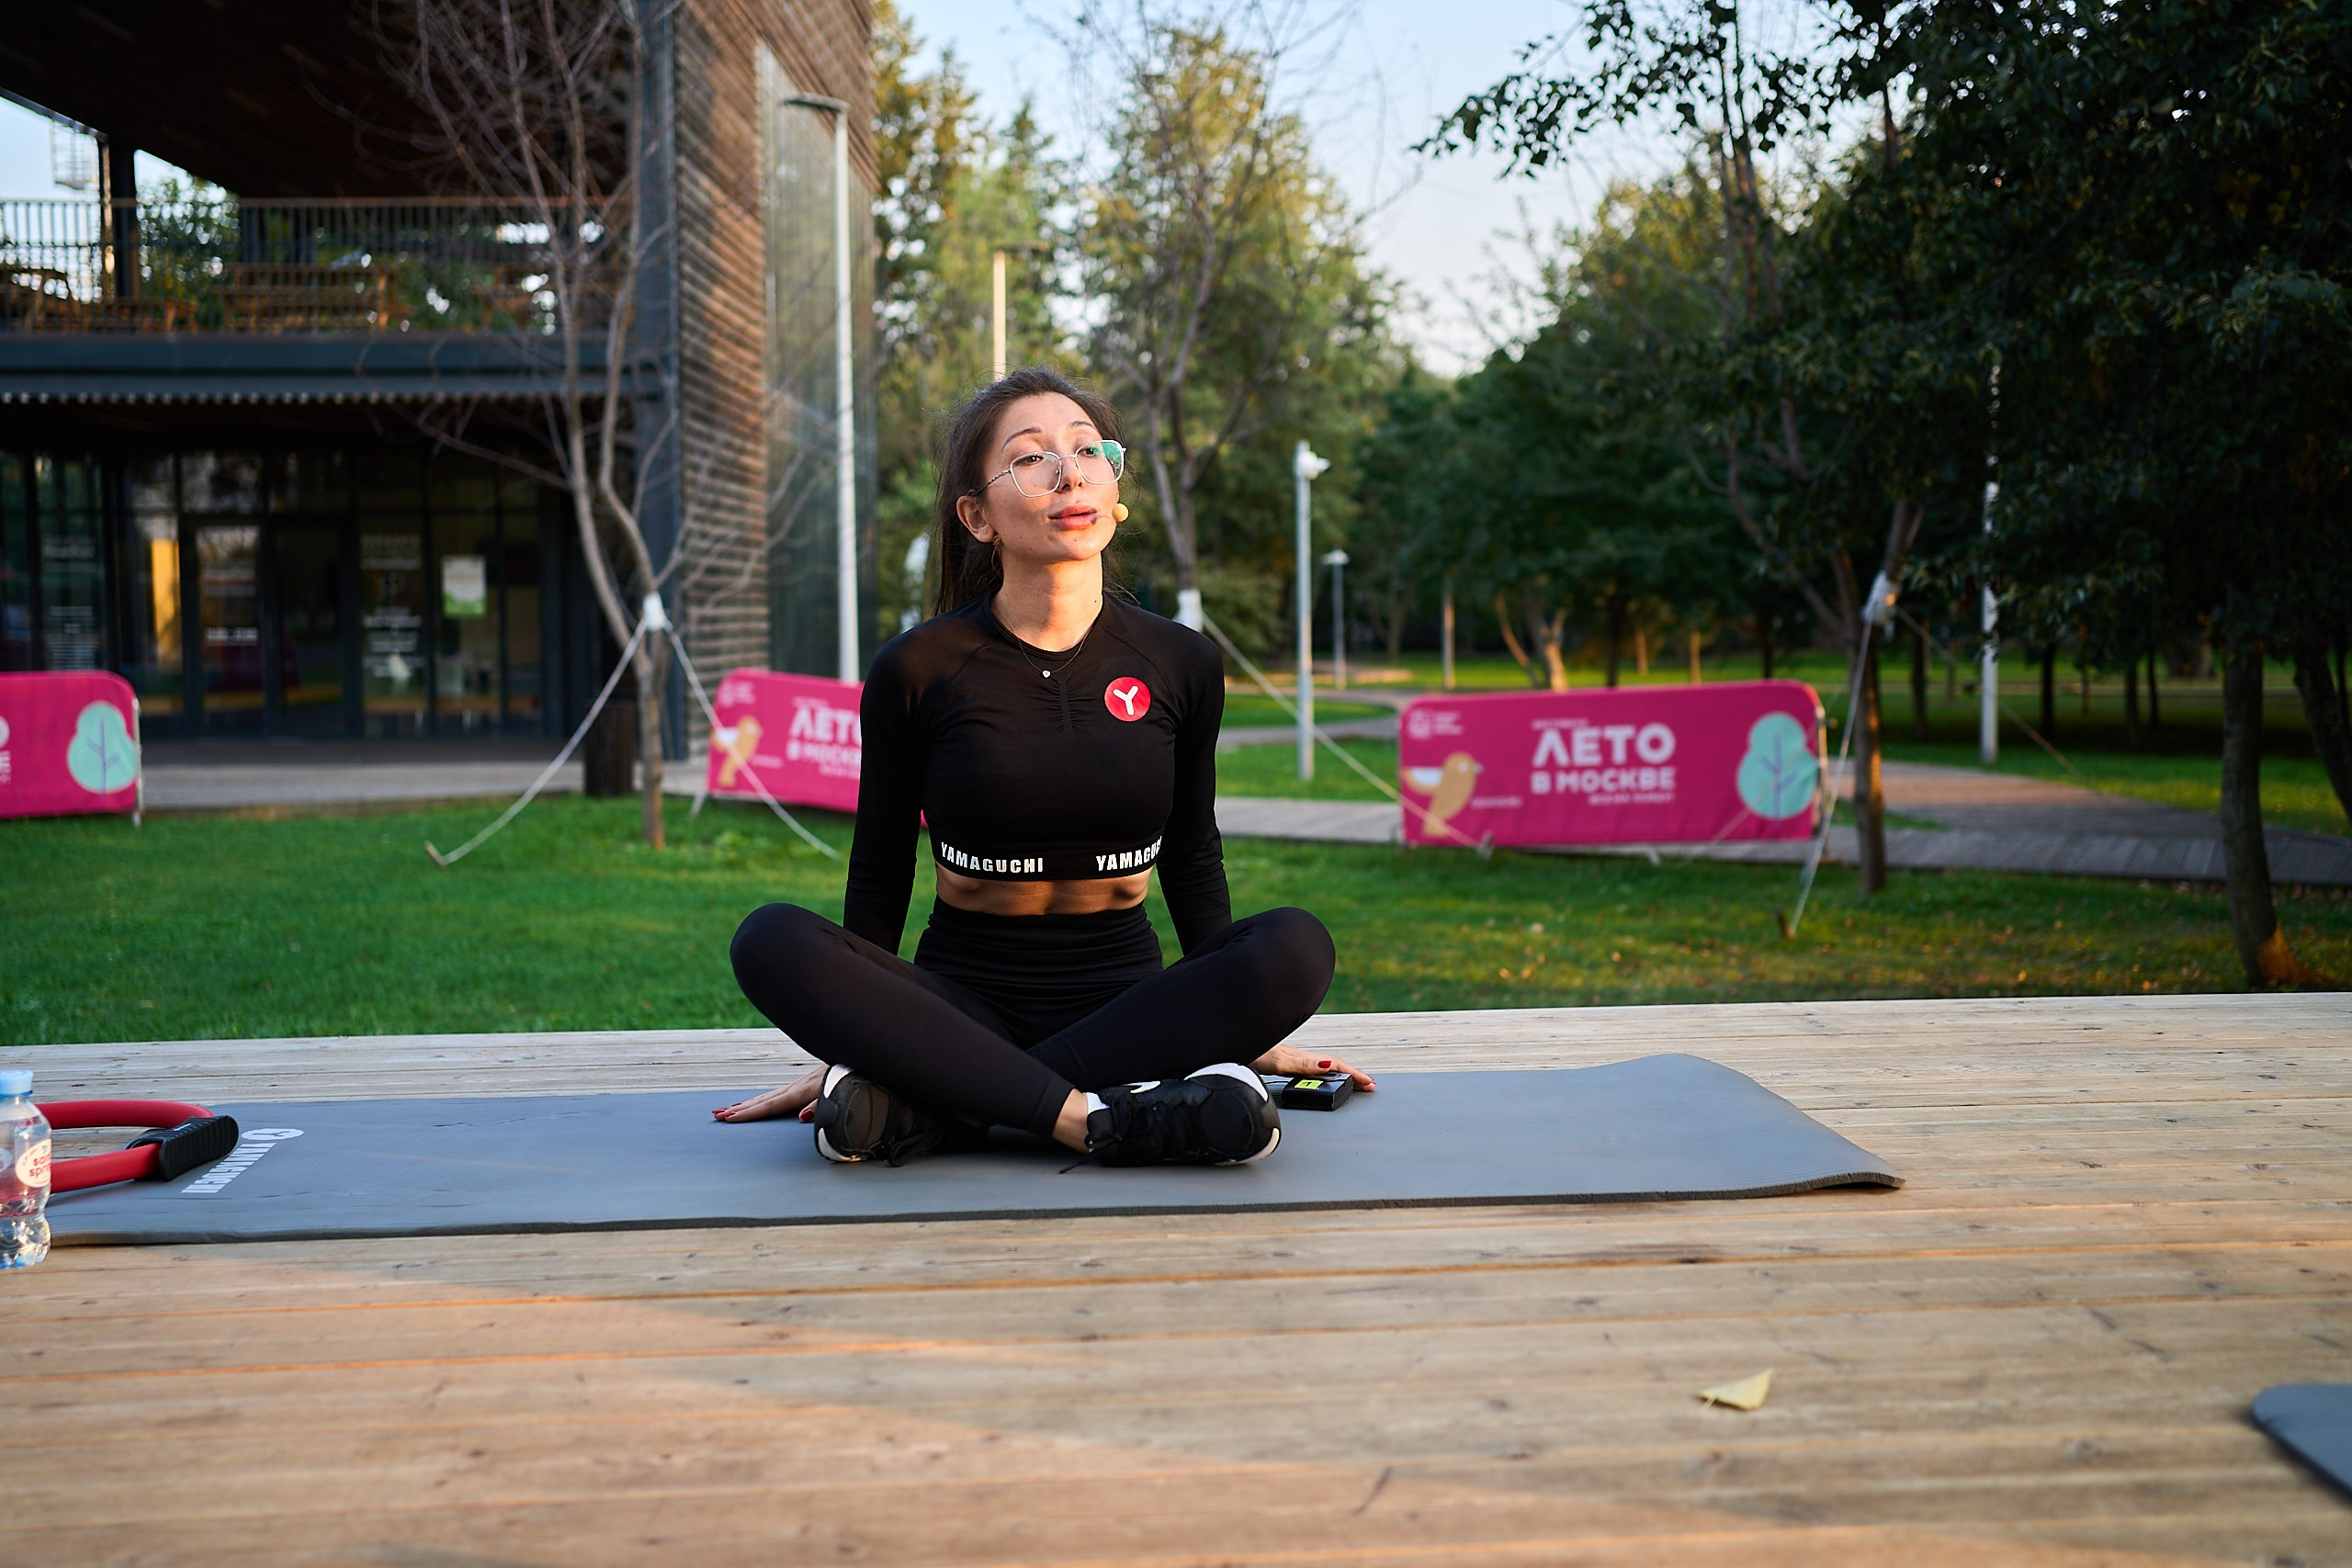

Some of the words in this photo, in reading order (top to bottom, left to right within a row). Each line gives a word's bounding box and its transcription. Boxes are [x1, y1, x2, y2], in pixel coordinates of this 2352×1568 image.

[1113, 685, 1139, 716] Y
[1532, 724, 1676, 766] ЛЕТО
[1531, 772, 1551, 794] В
[1556, 769, 1677, 793] МОСКВЕ
[941, 841, 1044, 874] YAMAGUCHI
[1096, 836, 1162, 872] YAMAGUC
